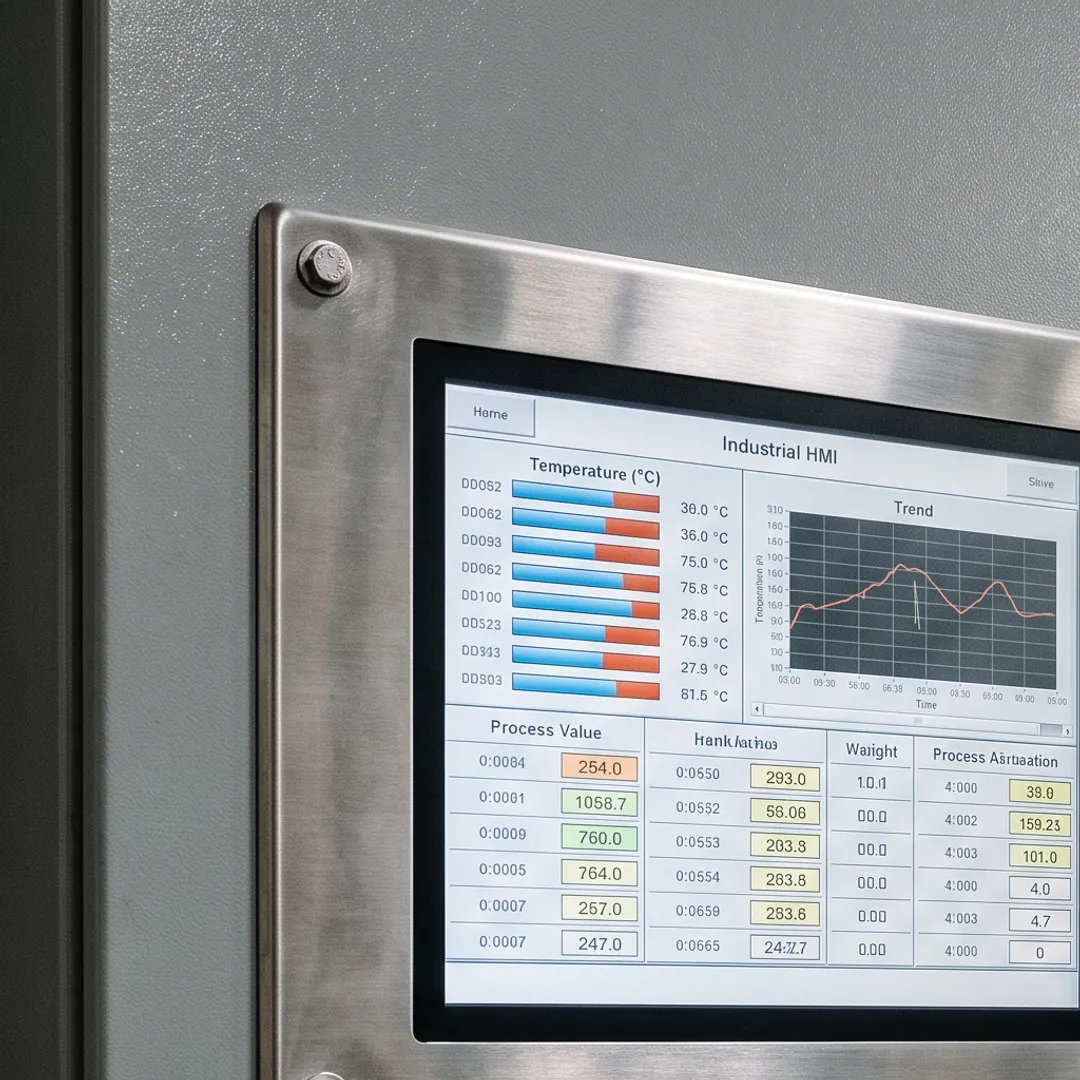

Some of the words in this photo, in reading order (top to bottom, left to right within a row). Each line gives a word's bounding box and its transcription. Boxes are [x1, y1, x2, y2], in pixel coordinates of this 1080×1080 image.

[722, 435, 801, 460] Industrial
[807, 446, 836, 464] HMI
[530, 457, 626, 482] Temperature
[632, 469, 660, 487] (°C)
[714, 505, 728, 517] °C
[894, 501, 933, 517] Trend
[681, 529, 707, 542] 36.0
[713, 532, 728, 544] °C
[681, 555, 707, 568] 75.0
[714, 558, 728, 570] °C
[714, 585, 728, 596] °C
[714, 611, 728, 623] °C
[681, 635, 707, 648] 76.9
[714, 637, 728, 649] °C
[681, 662, 707, 674] 27.9
[714, 664, 728, 676] °C
[714, 690, 727, 702] °C
[492, 720, 553, 736] Process
[560, 724, 601, 739] Value
[934, 748, 985, 763] Process
[579, 760, 621, 775] 254.0
[767, 771, 806, 785] 293.0
[576, 796, 626, 810] 1058.7
[579, 831, 621, 845] 760.0
[1022, 850, 1058, 865] 101.0
[579, 866, 621, 880] 764.0
[1031, 883, 1050, 895] 4.0
[1031, 915, 1050, 927] 4.7
[578, 936, 622, 952] 247.0
[1036, 946, 1045, 960] 0
